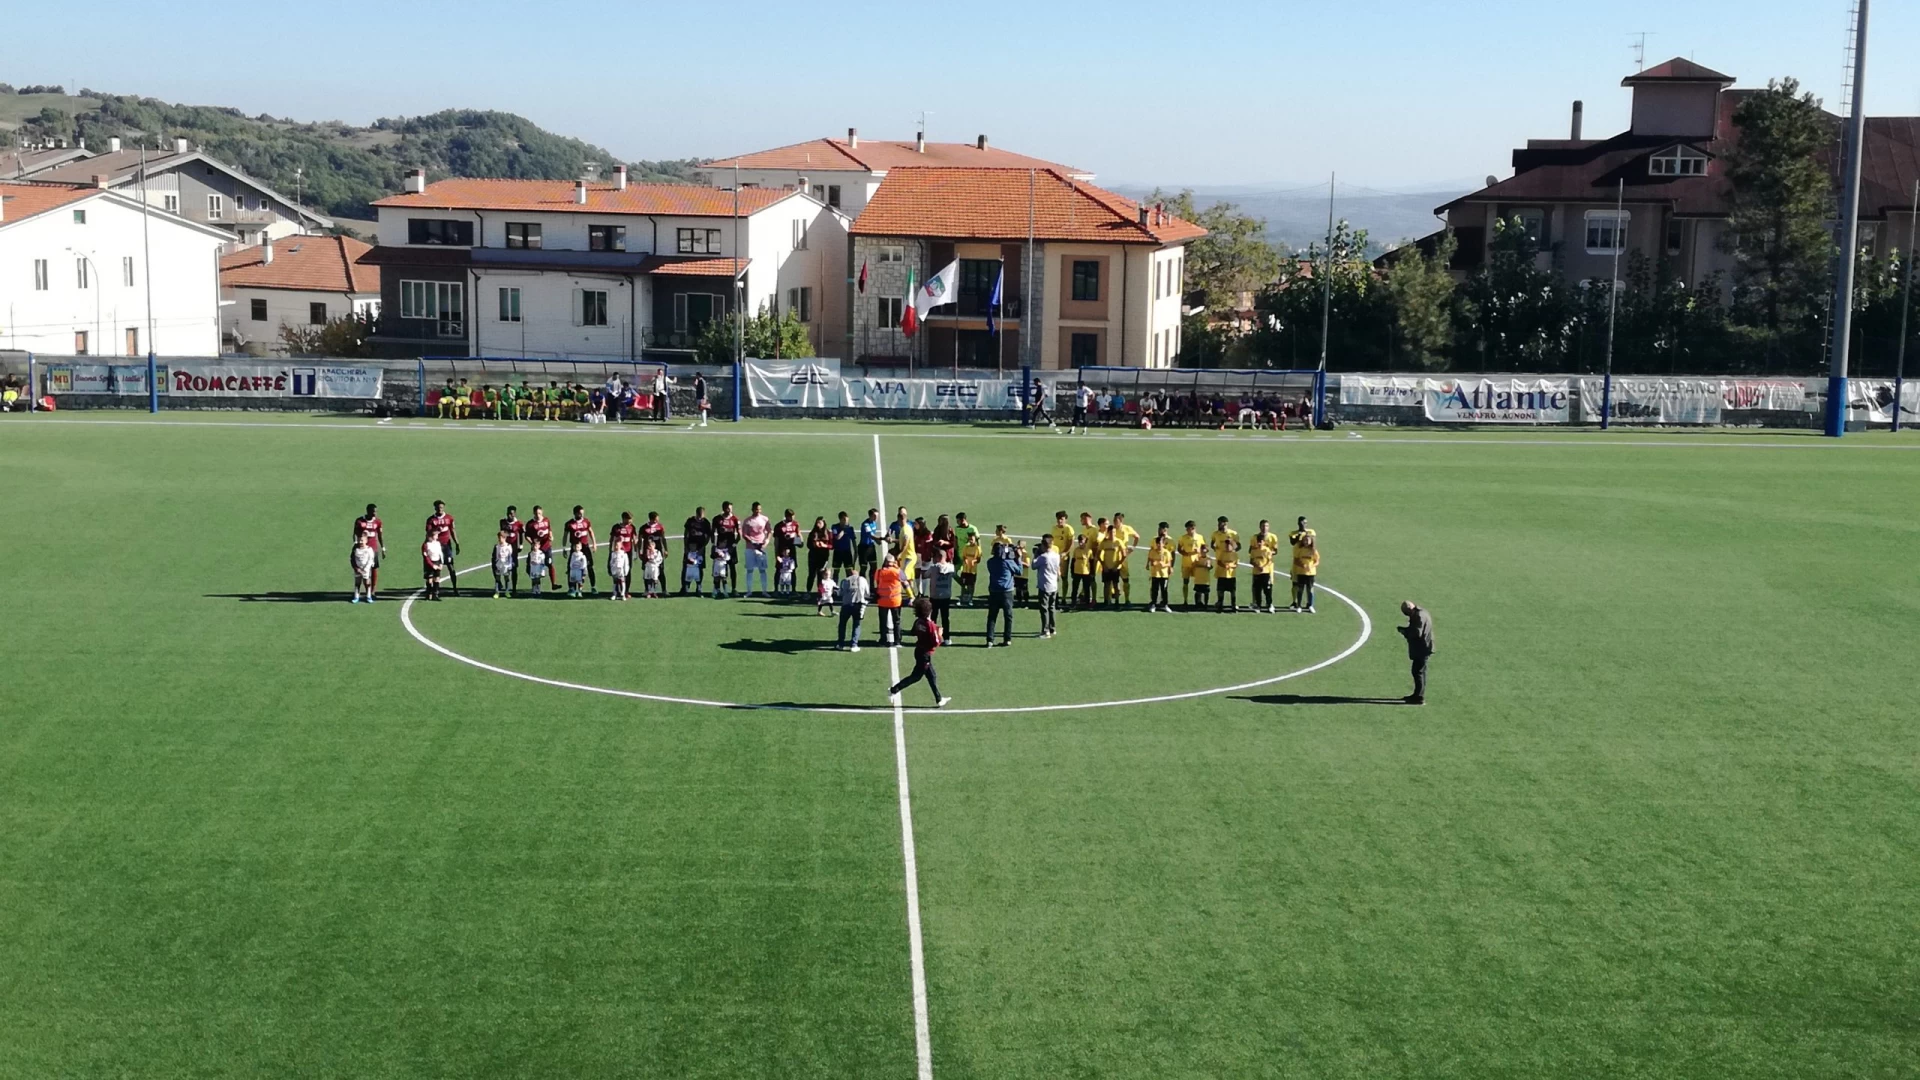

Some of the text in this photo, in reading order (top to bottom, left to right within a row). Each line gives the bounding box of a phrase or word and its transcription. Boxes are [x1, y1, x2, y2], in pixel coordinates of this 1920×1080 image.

[53, 375, 69, 384] MD
[74, 374, 97, 382] Buona
[872, 381, 907, 395] AFA
[1445, 383, 1567, 410] Atlante
[1457, 411, 1497, 420] VENAFRO
[1502, 412, 1538, 420] AGNONE
